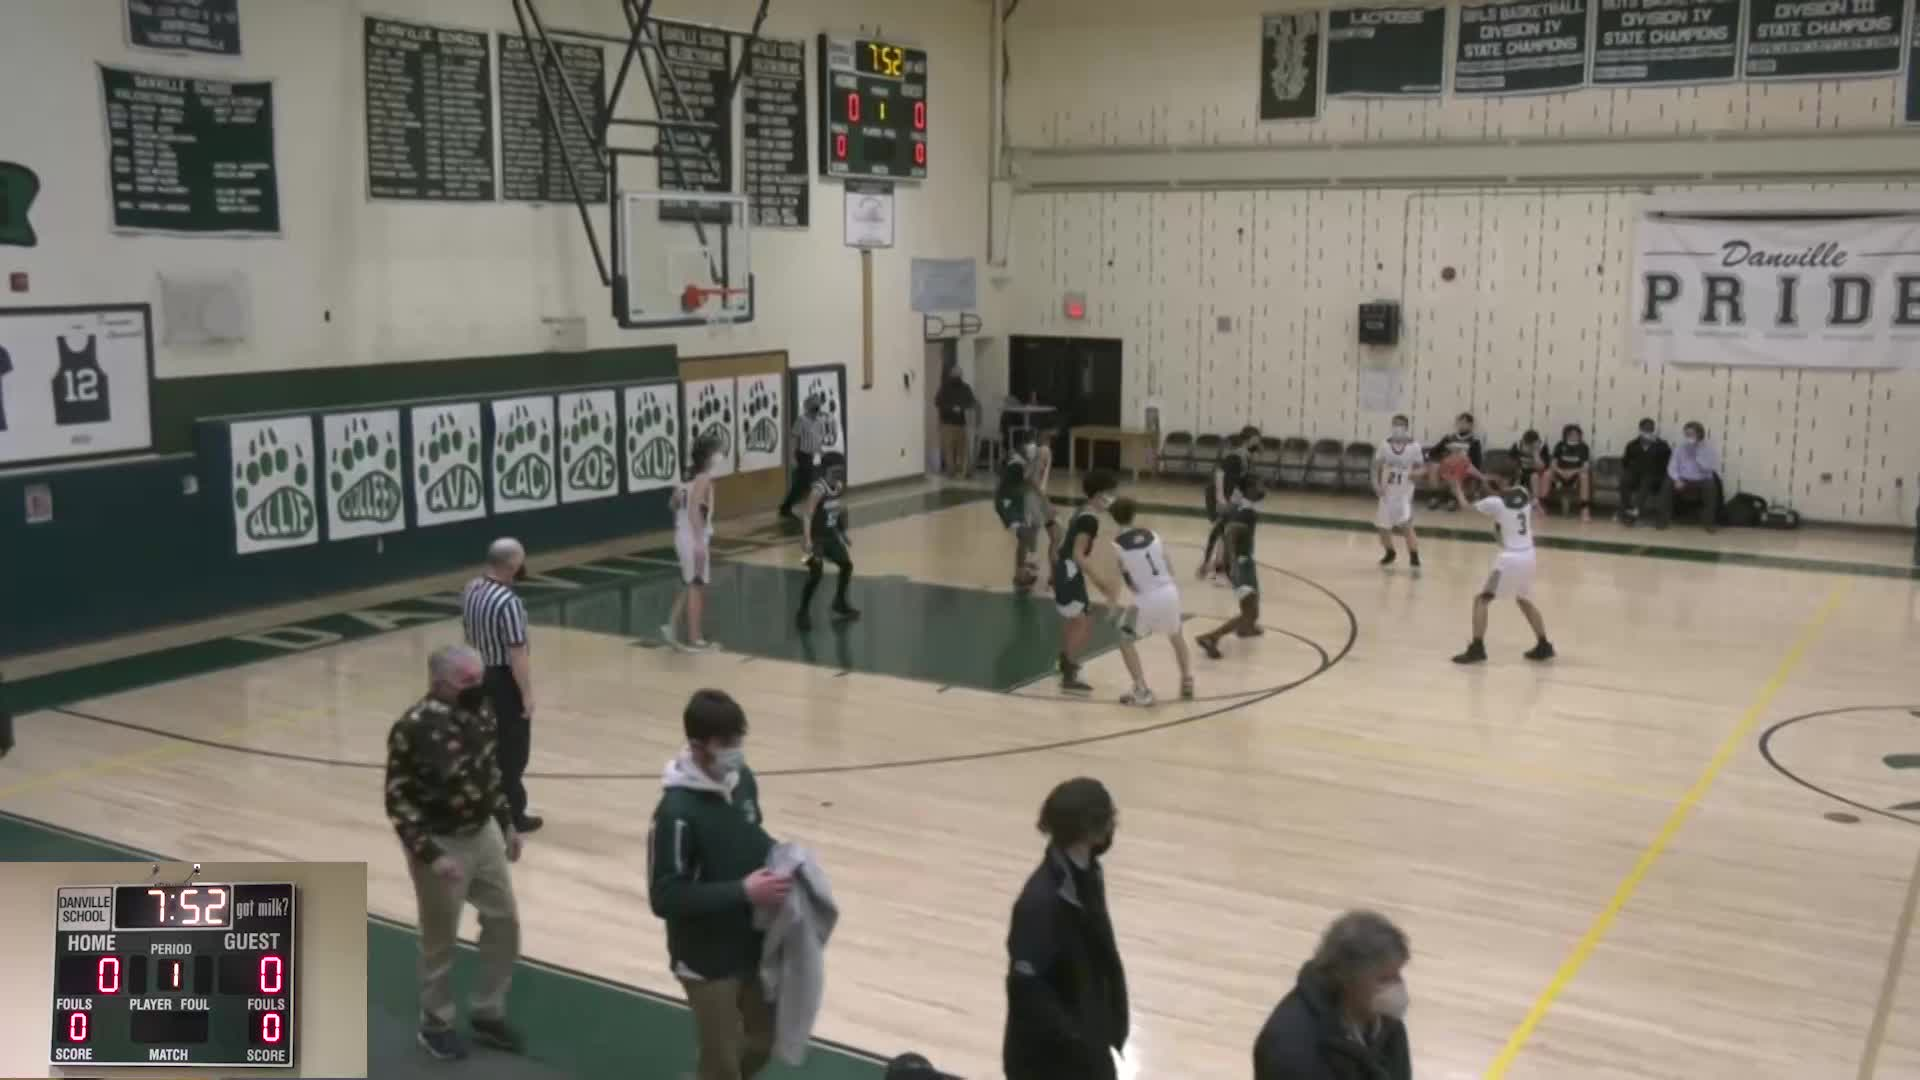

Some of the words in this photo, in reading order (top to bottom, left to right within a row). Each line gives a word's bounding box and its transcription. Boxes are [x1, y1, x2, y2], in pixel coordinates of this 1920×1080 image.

[1620, 9, 1688, 27] DIVISION
[1692, 8, 1712, 23] IV
[1774, 0, 1847, 19] DIVISION
[1479, 22, 1540, 39] DIVISION
[1544, 19, 1562, 33] IV
[1603, 30, 1647, 46] STATE
[1649, 25, 1729, 44] CHAMPIONS
[1758, 21, 1803, 38] STATE
[1807, 15, 1892, 35] CHAMPIONS
[1464, 41, 1502, 58] STATE
[1506, 36, 1578, 55] CHAMPIONS
[847, 92, 860, 122] 0
[914, 101, 926, 130] 0
[836, 133, 847, 158] 0
[1722, 240, 1848, 267] Danville
[1641, 272, 1920, 327] PRIDE
[63, 368, 99, 402] 12
[430, 466, 479, 510] AVA
[250, 487, 311, 537] ALLIE
[1516, 512, 1528, 536] 3
[1144, 551, 1160, 576] 1
